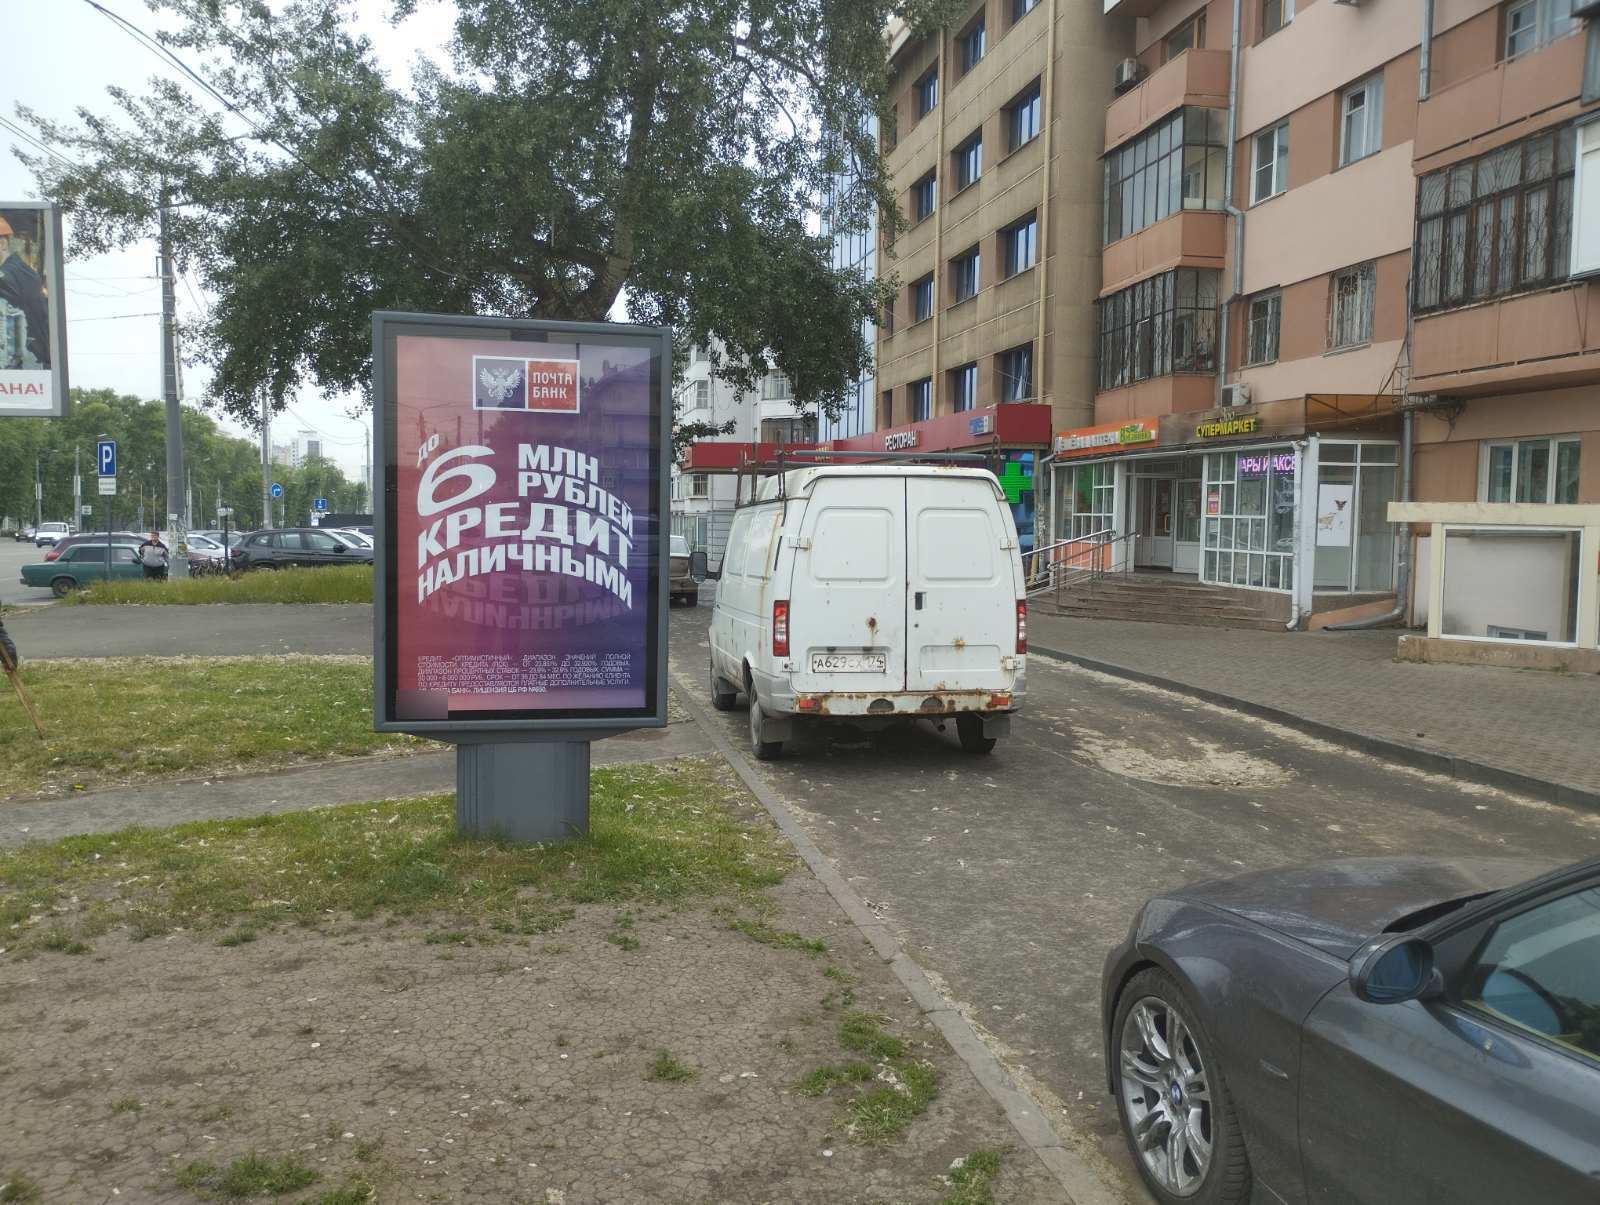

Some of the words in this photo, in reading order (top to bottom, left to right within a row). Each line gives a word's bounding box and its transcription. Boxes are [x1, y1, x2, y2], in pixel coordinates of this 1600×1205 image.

[0, 383, 44, 395] АНА!
[532, 371, 573, 385] ПОЧТА
[532, 386, 567, 400] БАНК
[885, 430, 916, 451] РЕСТОРАН
[1196, 419, 1255, 437] СУПЕРМАРКЕТ
[518, 443, 598, 483] МЛН
[417, 445, 497, 517] 6
[518, 471, 633, 539] РУБЛЕЙ
[418, 503, 633, 570] КРЕДИТ
[418, 543, 632, 610] НАЛИЧНЫМИ
